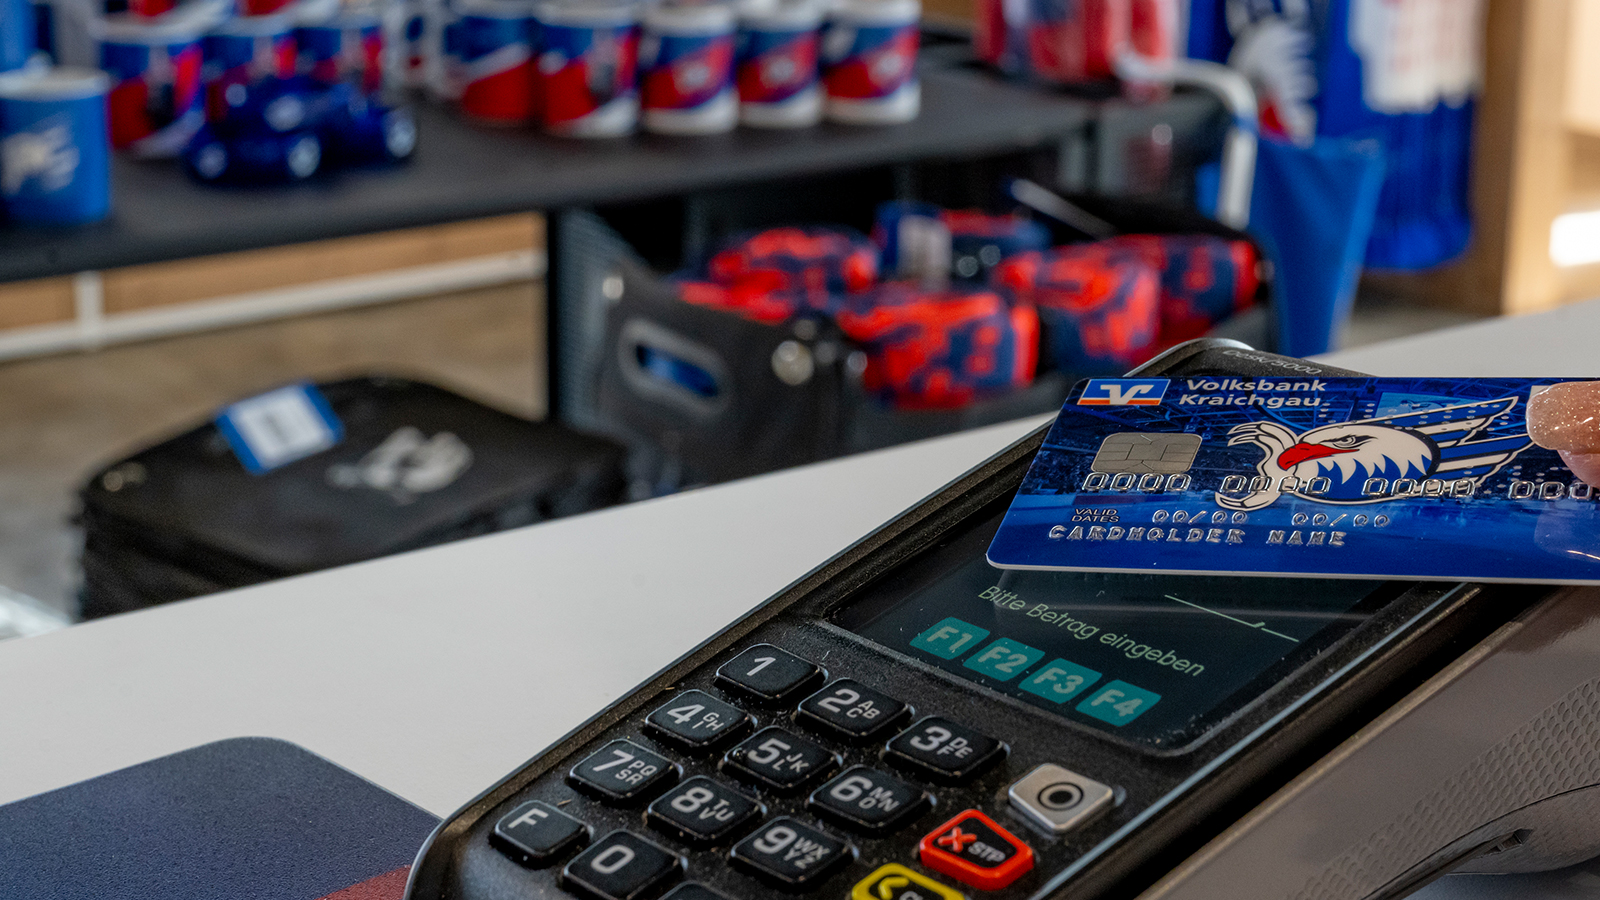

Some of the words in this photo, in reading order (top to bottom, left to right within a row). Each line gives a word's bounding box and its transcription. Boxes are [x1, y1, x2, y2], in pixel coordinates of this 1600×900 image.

[1186, 379, 1327, 391] Volksbank
[1178, 394, 1322, 409] Kraichgau
[1081, 472, 1192, 492] 0000
[1219, 474, 1332, 494] 0000
[1071, 515, 1120, 523] DATES
[1074, 508, 1118, 516] VALID
[1152, 509, 1248, 524] 00/00
[1291, 512, 1391, 527] 00/00
[1048, 525, 1246, 545] CARDHOLDER
[1265, 529, 1347, 546] NAME
[978, 585, 1026, 611] Bitte
[1026, 603, 1100, 640] Betrag
[1099, 633, 1206, 677] eingeben
[746, 656, 777, 677] 1
[926, 625, 973, 653] F1
[977, 646, 1029, 673] F2
[1033, 667, 1085, 695] F3
[1090, 688, 1144, 717] F4
[817, 688, 860, 714] 2
[667, 703, 706, 725] 4
[909, 725, 953, 751] 3
[592, 749, 635, 773] 7
[747, 738, 792, 765] 5
[829, 775, 874, 802] 6
[670, 786, 715, 814] 8
[507, 807, 550, 830] F
[753, 825, 798, 855] 9
[967, 841, 1007, 863] STP
